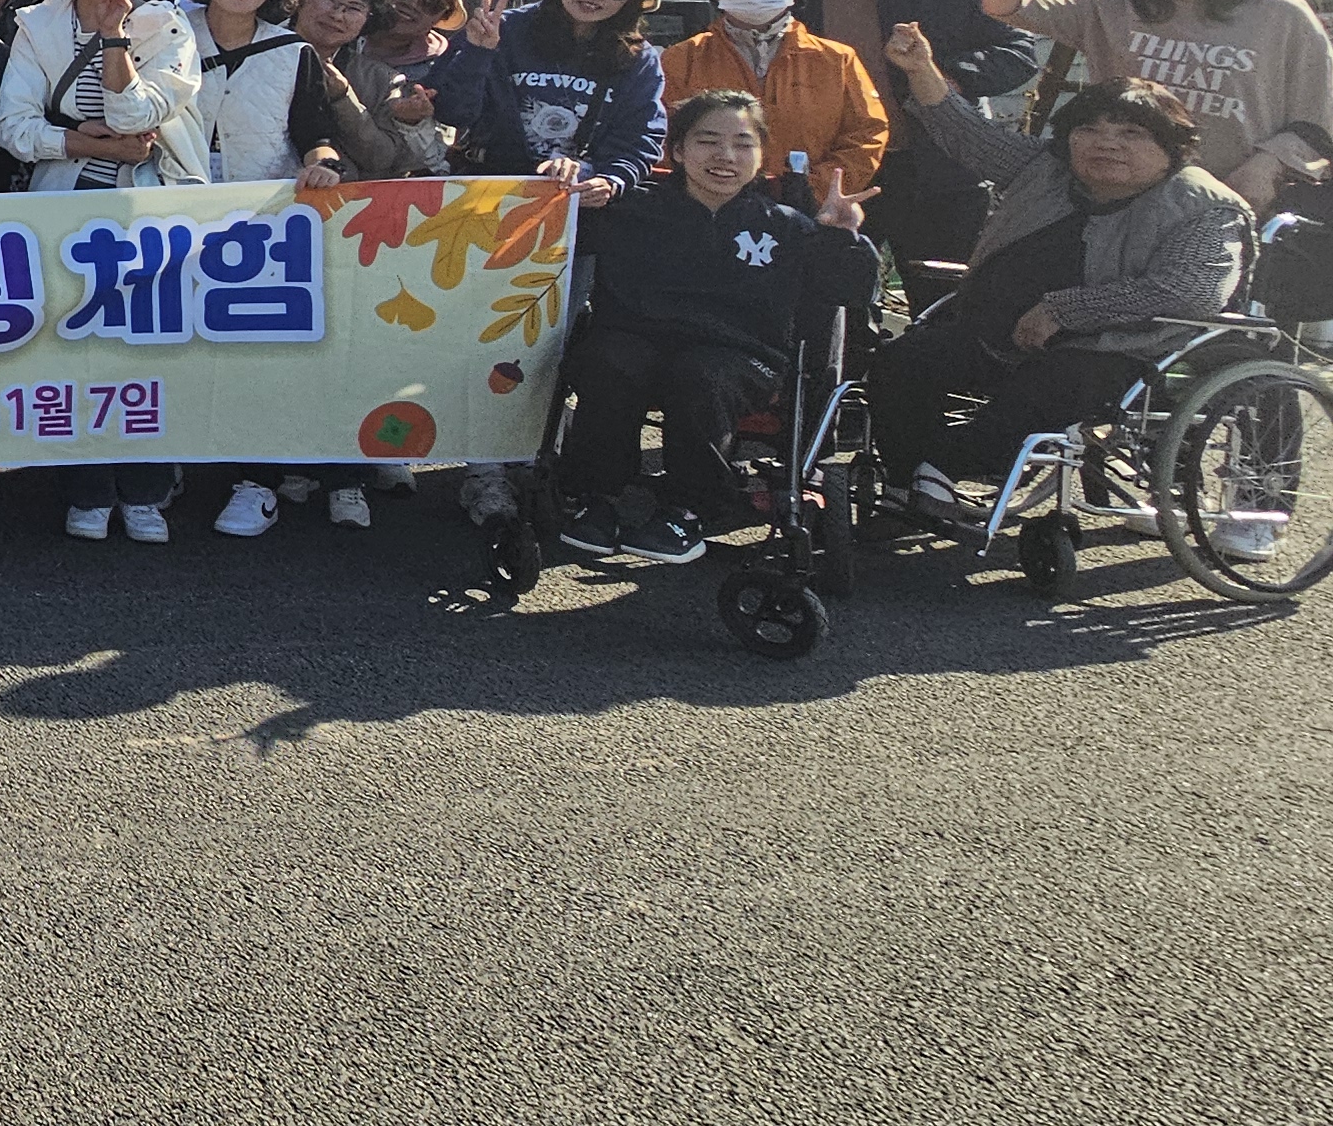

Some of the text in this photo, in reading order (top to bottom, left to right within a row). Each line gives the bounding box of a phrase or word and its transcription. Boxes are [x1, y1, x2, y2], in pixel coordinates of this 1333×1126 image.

[1129, 30, 1258, 73] THINGS
[1137, 56, 1231, 91] THAT
[733, 229, 780, 268] NY
[62, 212, 315, 335] 체험
[89, 380, 162, 434] 7일
